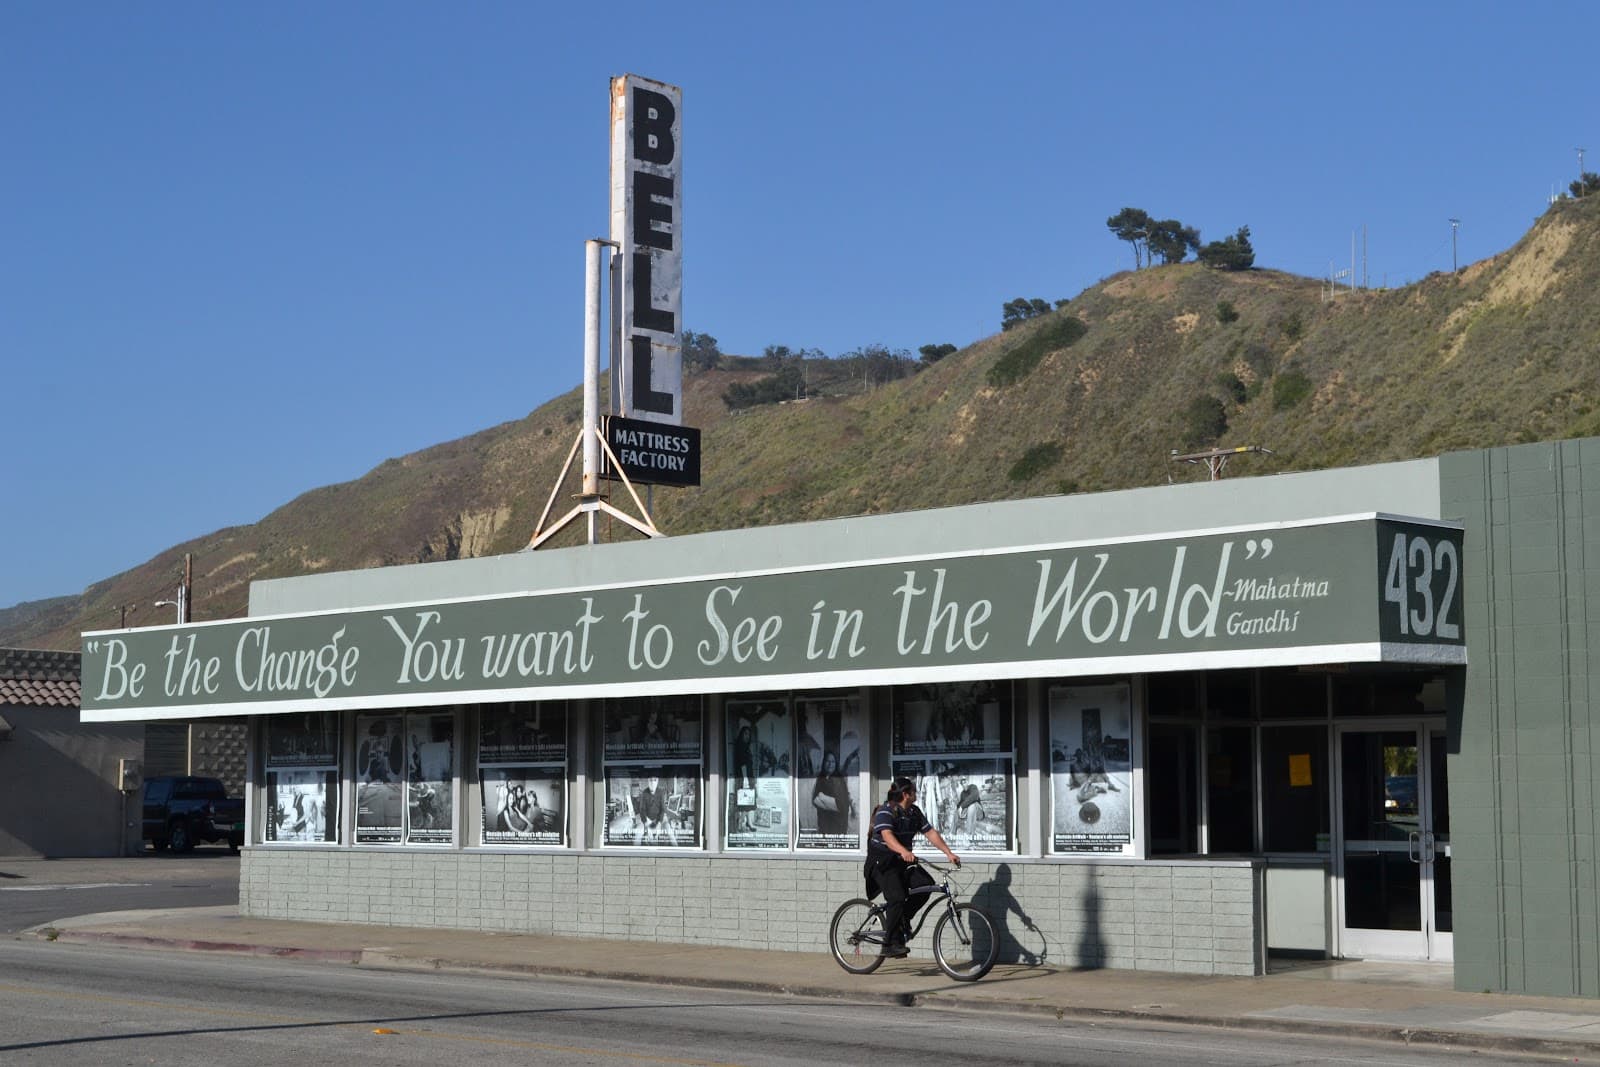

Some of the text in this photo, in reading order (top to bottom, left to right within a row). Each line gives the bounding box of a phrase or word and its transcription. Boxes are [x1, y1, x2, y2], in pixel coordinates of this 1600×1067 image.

[632, 83, 676, 415] BELL
[615, 428, 690, 453] MATTRESS
[620, 448, 686, 472] FACTORY
[1384, 532, 1460, 640] 432
[164, 633, 221, 698] the
[234, 625, 361, 700] Change
[381, 609, 467, 685] You
[479, 596, 606, 680] want
[621, 592, 674, 672] to
[697, 584, 784, 667] See
[806, 598, 866, 661] in
[892, 567, 994, 657] the
[1225, 609, 1301, 637] Gandhi
